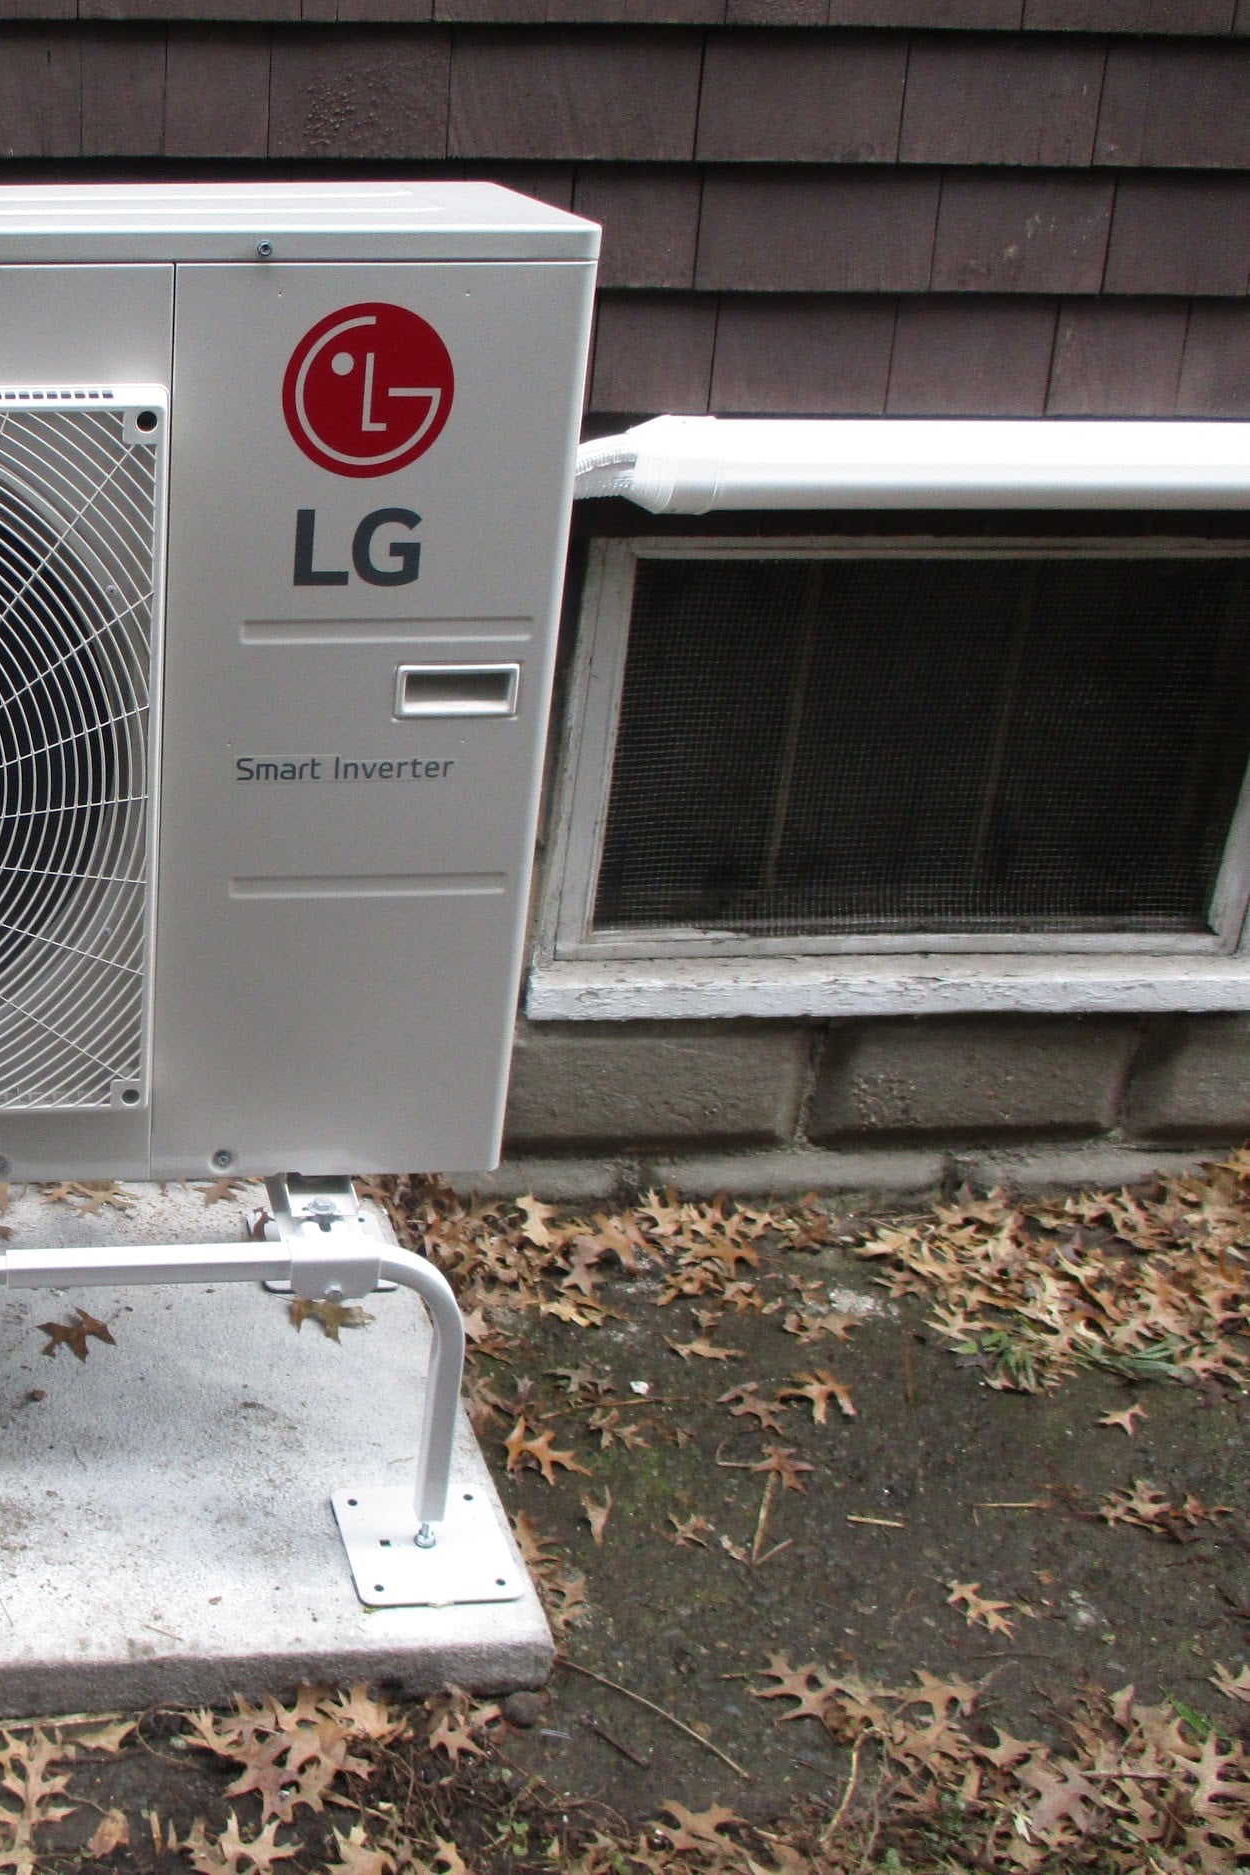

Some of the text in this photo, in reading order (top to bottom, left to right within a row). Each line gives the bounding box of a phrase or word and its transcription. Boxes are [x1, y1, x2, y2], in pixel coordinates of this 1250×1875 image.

[294, 315, 442, 466] LG
[293, 507, 422, 587] LG
[236, 757, 455, 781] Smart Inverter
